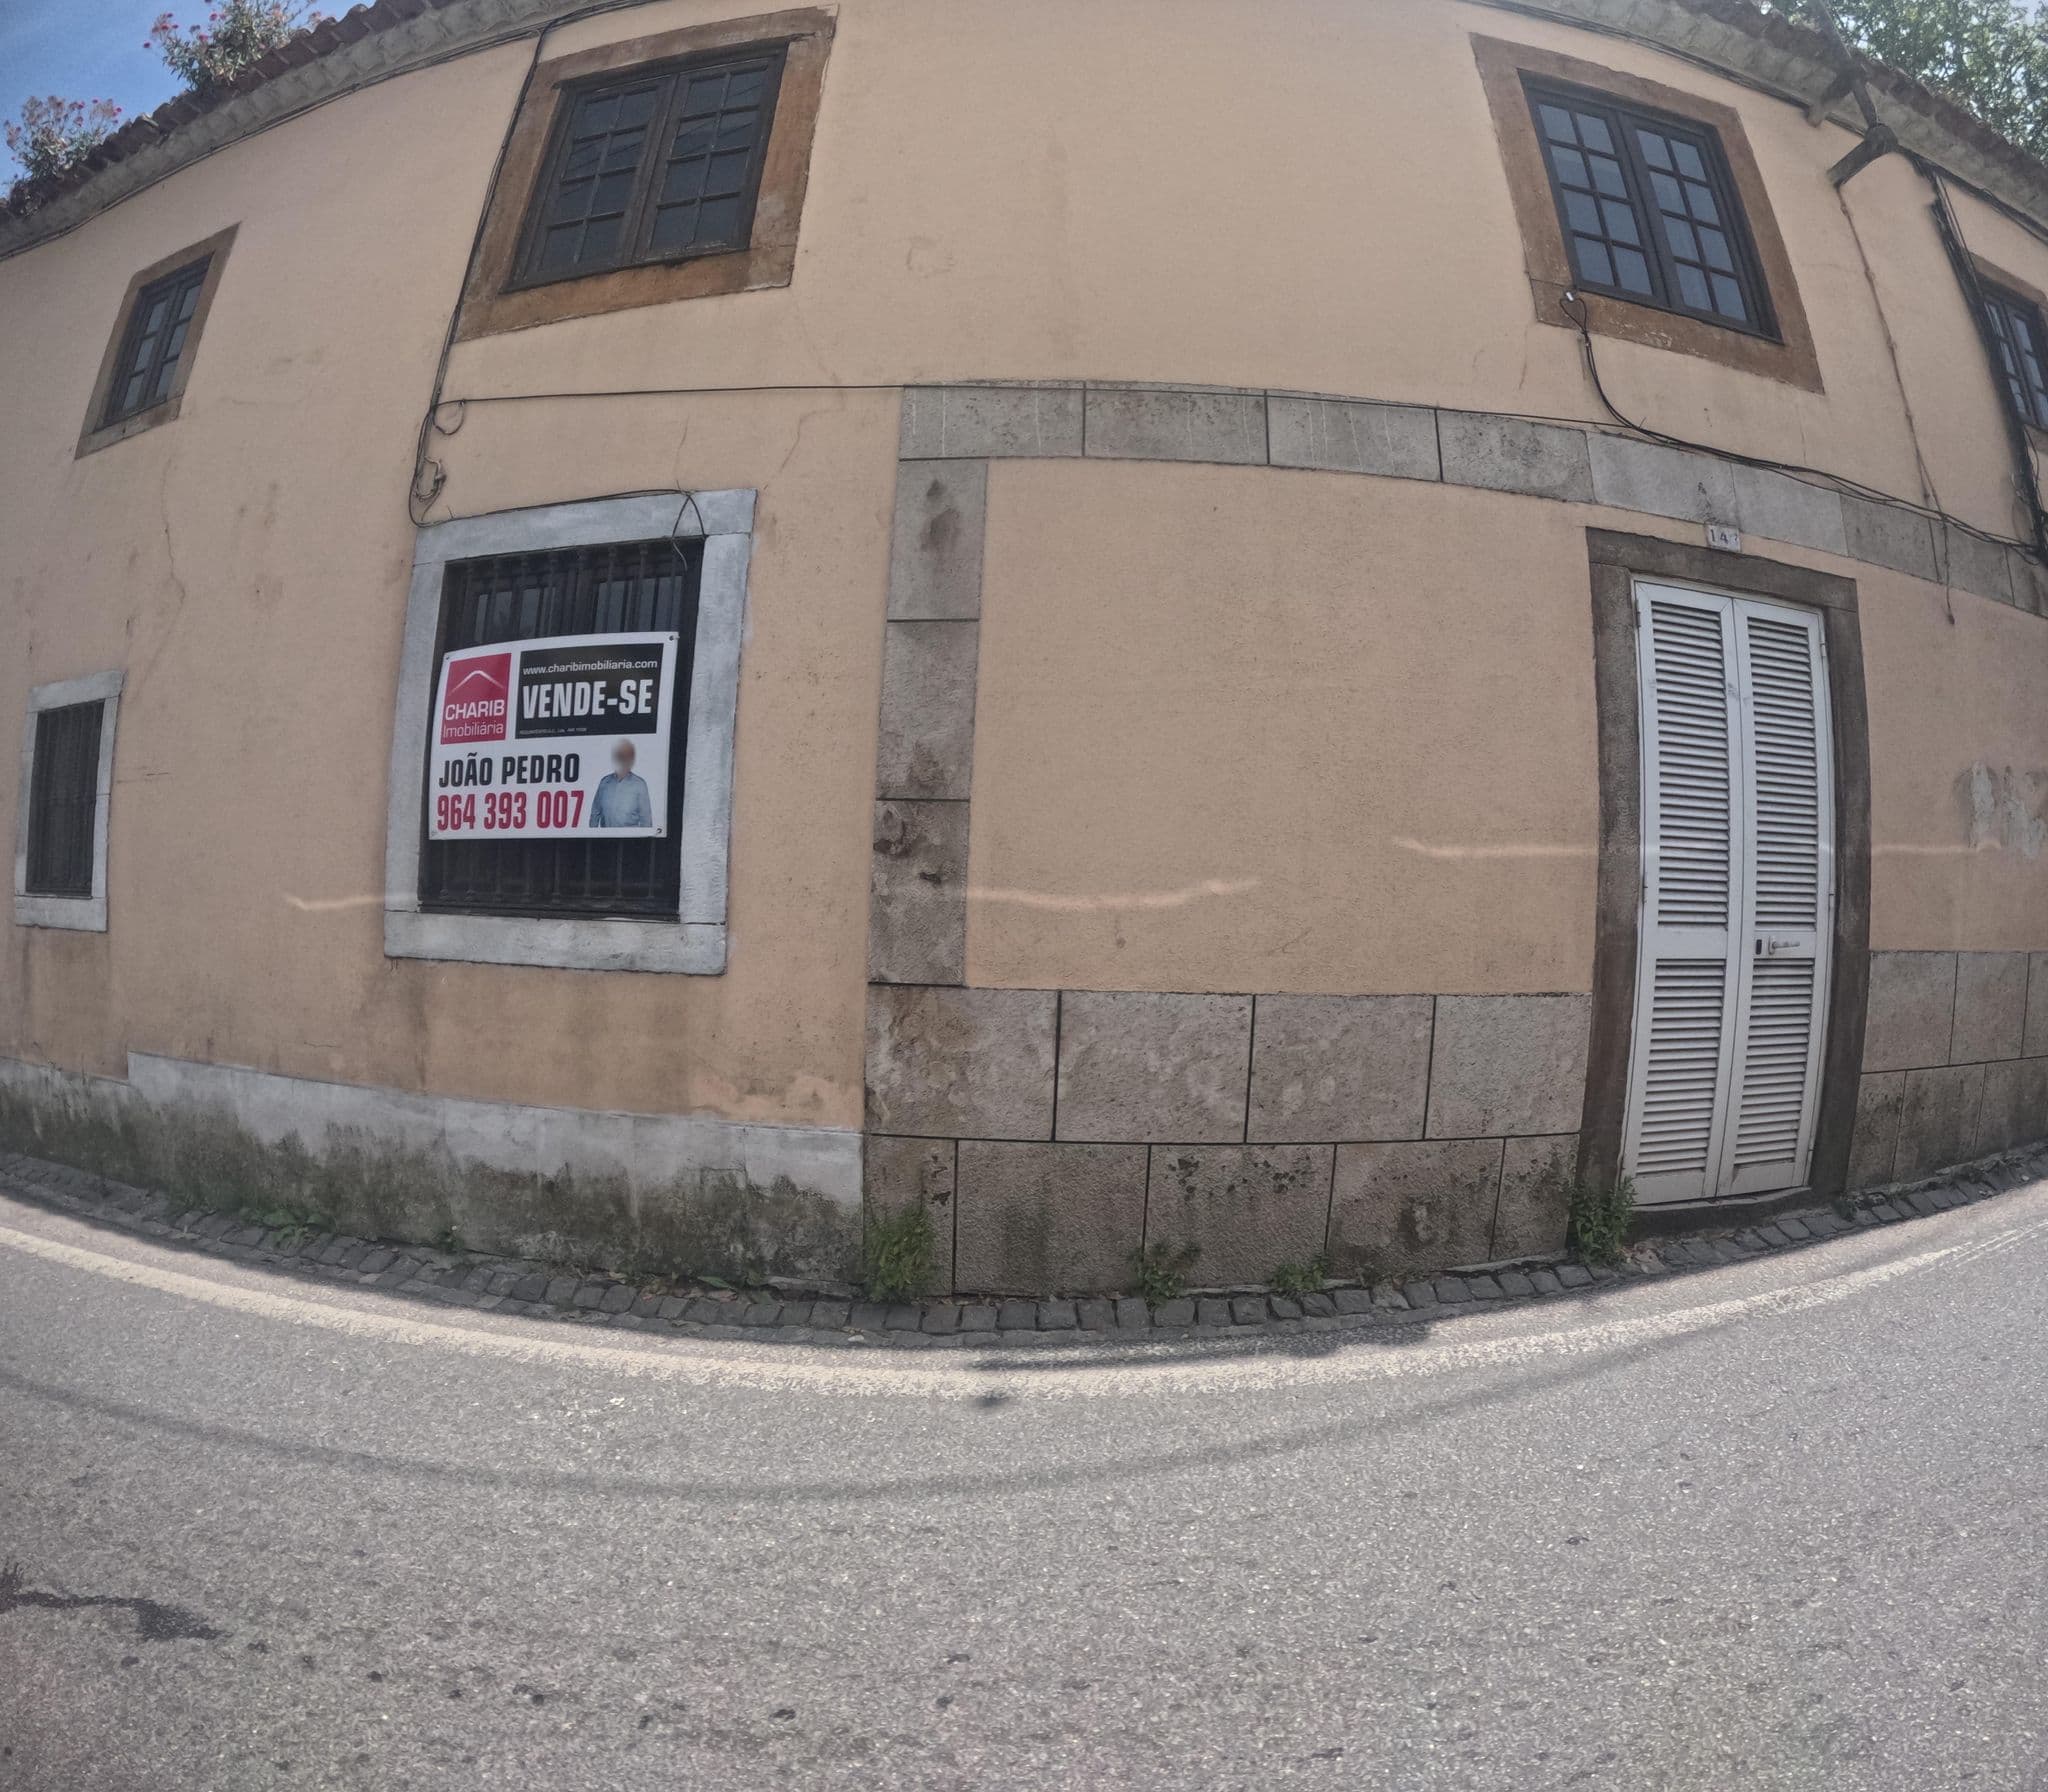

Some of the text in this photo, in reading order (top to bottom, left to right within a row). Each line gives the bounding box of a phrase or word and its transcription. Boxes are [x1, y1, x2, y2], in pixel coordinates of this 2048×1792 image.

[522, 659, 658, 676] www.charibimobiliaria.com
[445, 699, 505, 721] CHARIB
[522, 679, 653, 719] VENDE-SE
[442, 720, 504, 738] Imobiliária
[438, 752, 580, 788] JOÃO PEDRO
[437, 790, 584, 831] 964 393 007
